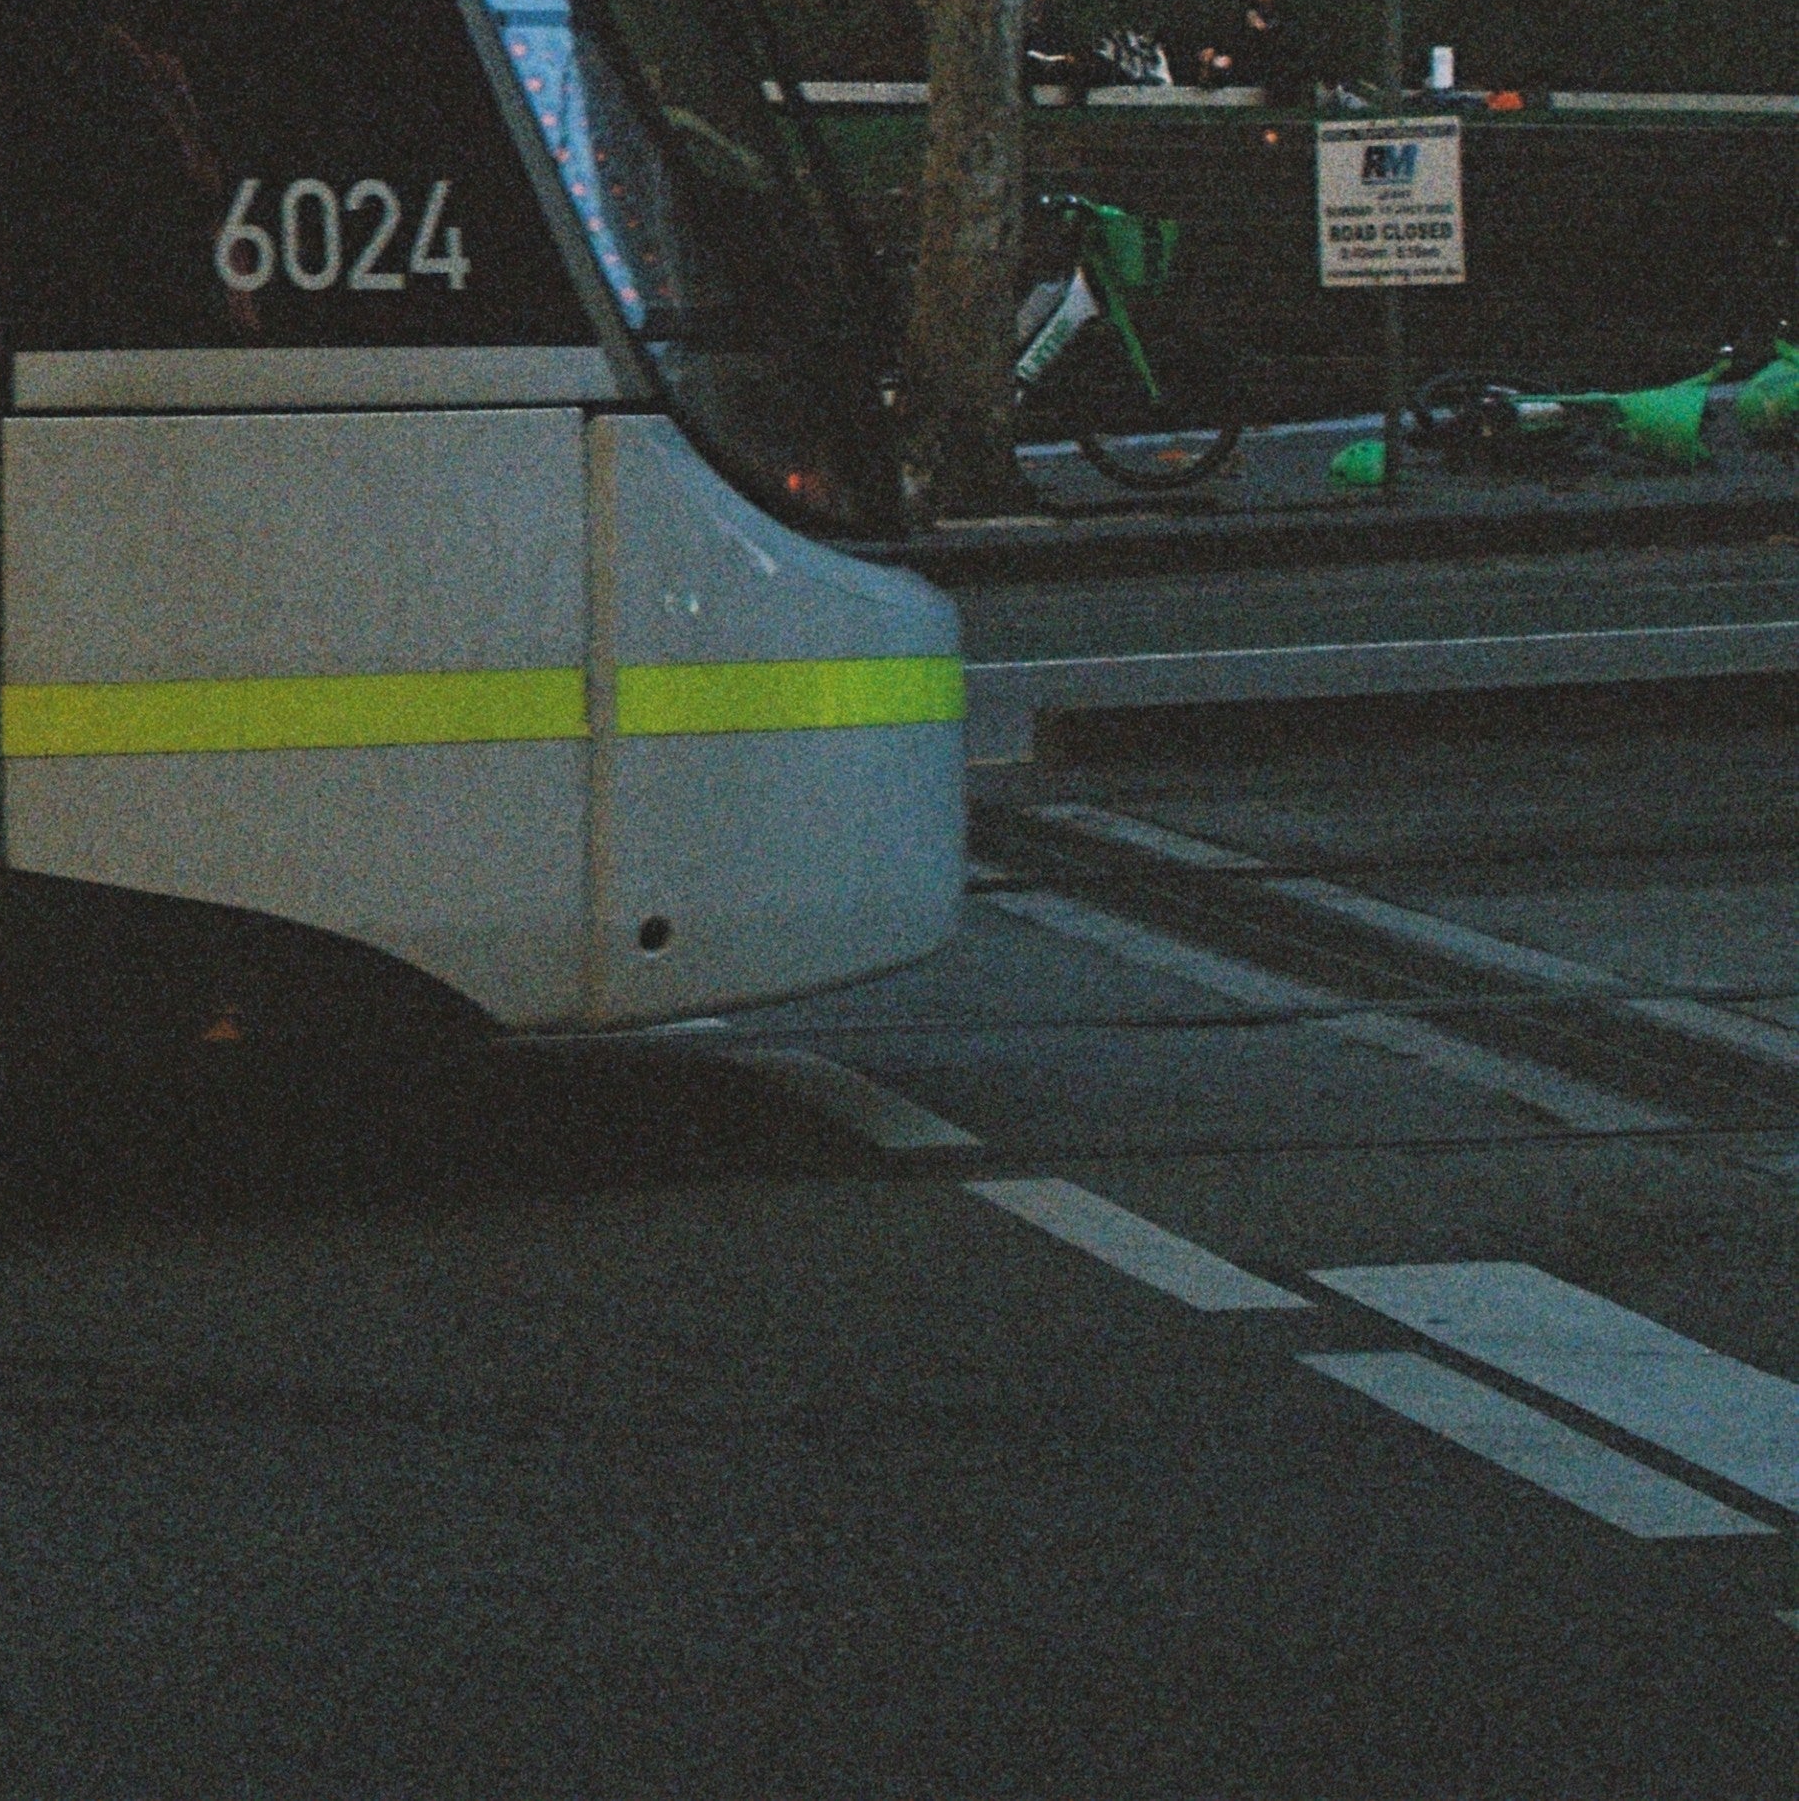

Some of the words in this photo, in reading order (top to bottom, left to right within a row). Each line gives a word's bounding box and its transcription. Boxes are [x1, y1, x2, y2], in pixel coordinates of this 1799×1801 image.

[213, 178, 472, 292] 6024
[1329, 224, 1378, 242] ROAD
[1381, 221, 1454, 241] CLOSED
